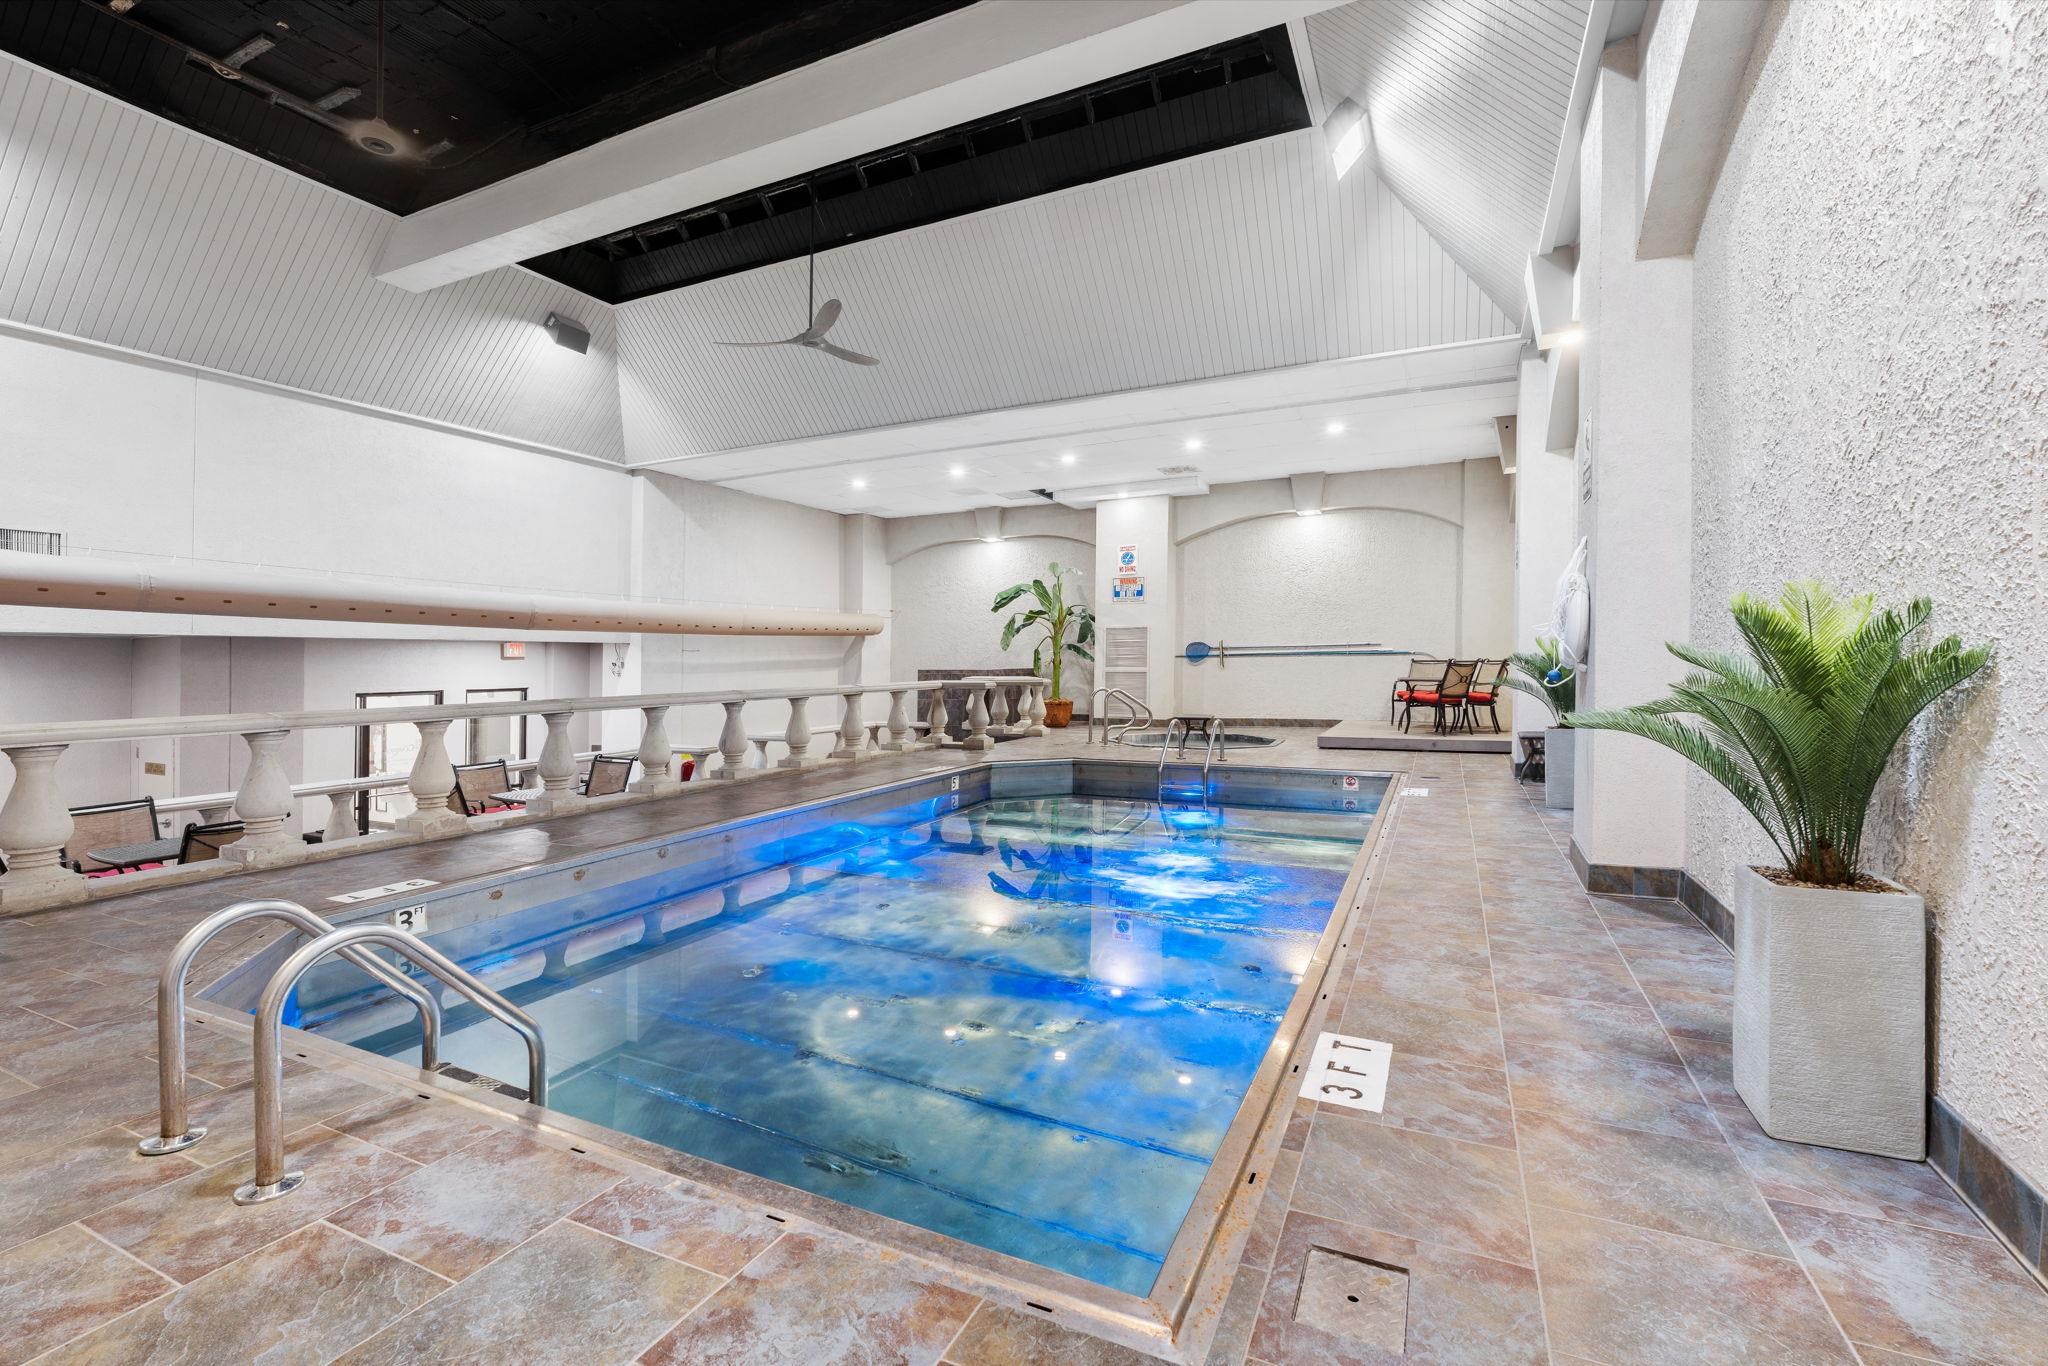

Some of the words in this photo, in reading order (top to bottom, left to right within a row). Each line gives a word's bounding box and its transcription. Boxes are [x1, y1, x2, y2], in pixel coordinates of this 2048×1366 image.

[399, 910, 413, 931] 3
[414, 906, 424, 915] FT
[1327, 1040, 1372, 1077] FT
[1320, 1084, 1364, 1100] 3
